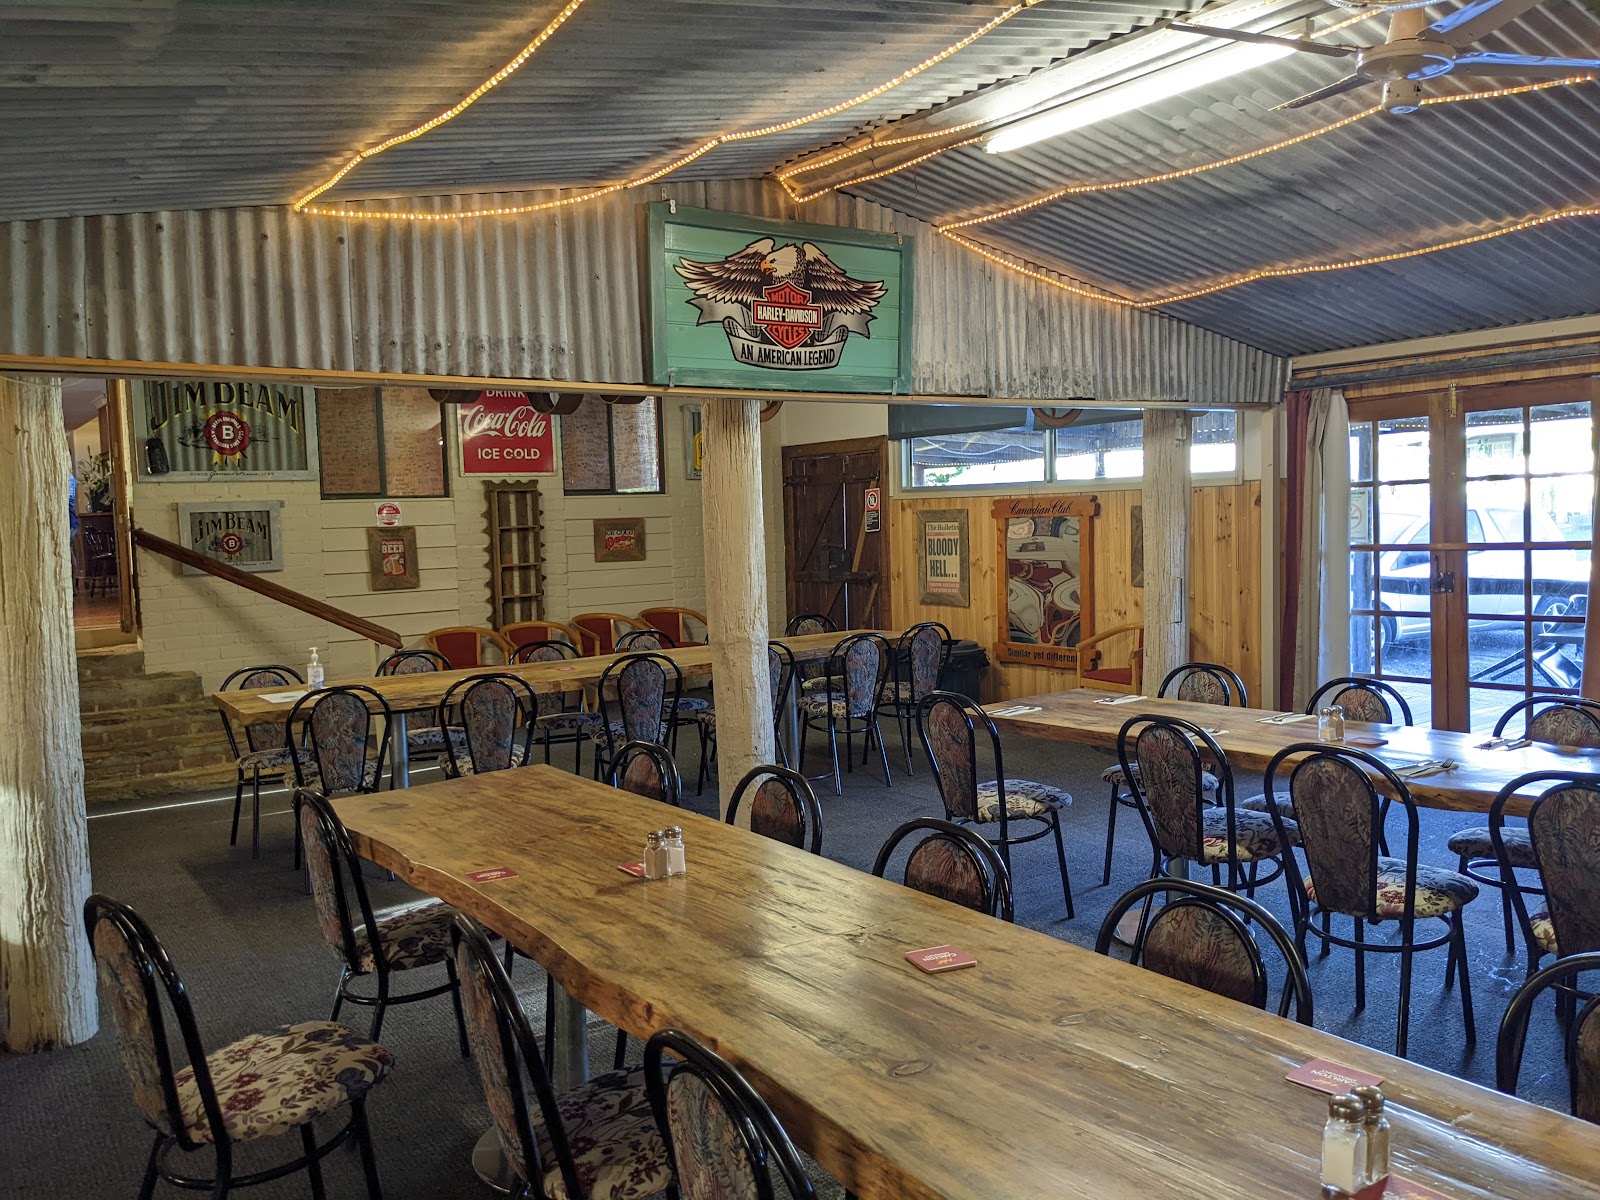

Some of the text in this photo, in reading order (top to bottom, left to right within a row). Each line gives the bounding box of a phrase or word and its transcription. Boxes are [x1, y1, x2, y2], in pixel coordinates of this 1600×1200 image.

[770, 288, 804, 304] MOTOR
[757, 305, 818, 323] HARLEY-DAVIDSON
[772, 325, 805, 344] CYCLES
[740, 342, 835, 366] AN AMERICAN LEGEND
[152, 382, 208, 433] JIM
[464, 405, 547, 438] Coca-Cola
[222, 425, 235, 440] B
[478, 448, 540, 460] ICE COLD
[1009, 499, 1074, 515] Canadian Club
[194, 519, 223, 544] JIM
[225, 512, 269, 542] BEAM
[228, 540, 236, 548] B
[381, 545, 405, 554] BEER
[928, 537, 959, 556] BLOODY
[929, 559, 958, 578] HELL...
[1007, 647, 1031, 658] Similar
[1033, 651, 1044, 660] yet
[922, 951, 957, 962] CARLTON
[1310, 1069, 1358, 1087] CARLTON
